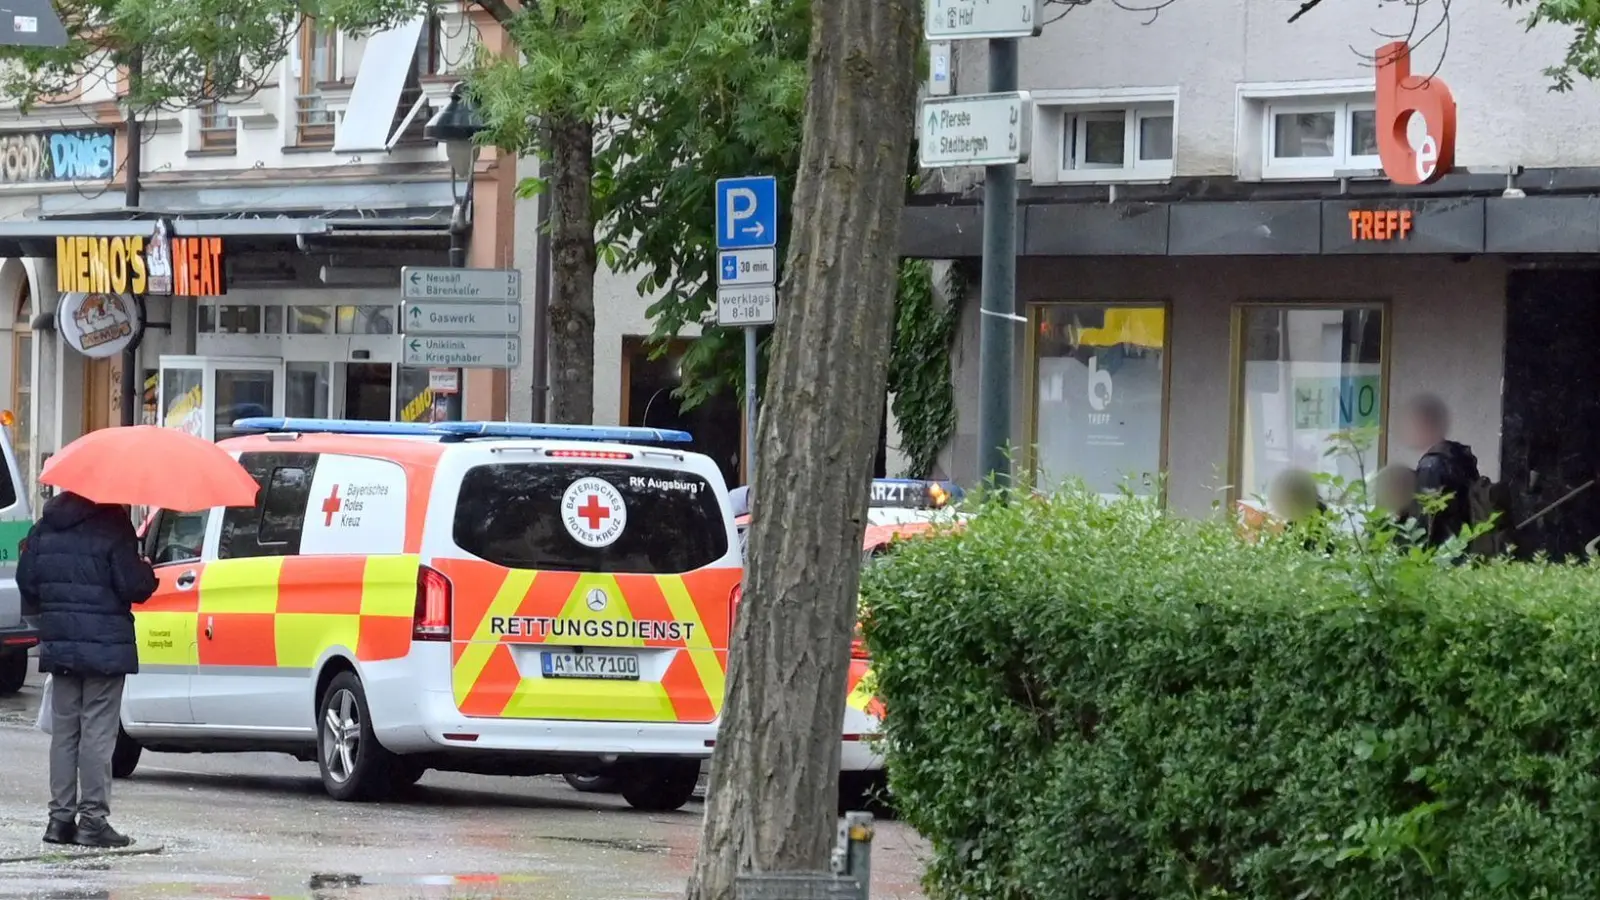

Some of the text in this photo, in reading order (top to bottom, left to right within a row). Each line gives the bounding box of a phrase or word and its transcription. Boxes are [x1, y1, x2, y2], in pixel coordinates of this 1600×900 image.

[726, 187, 758, 240] P
[1348, 210, 1413, 240] TREFF
[56, 235, 223, 296] MEMO'S MEAT
[426, 284, 480, 296] Bärenkeller
[722, 293, 771, 306] werktags
[429, 312, 476, 324] Gaswerk
[425, 339, 466, 350] Uniklinik
[425, 352, 482, 364] Kriegshaber
[346, 483, 389, 498] Bayerisches
[629, 476, 706, 493] RK Augsburg 7
[566, 482, 622, 512] BAYERISCHES
[343, 498, 364, 512] Rotes
[341, 514, 361, 529] Kreuz
[568, 516, 622, 543] ROTES KREUZ
[490, 616, 695, 640] RETTUNGSDIENST
[598, 657, 637, 673] 7100
